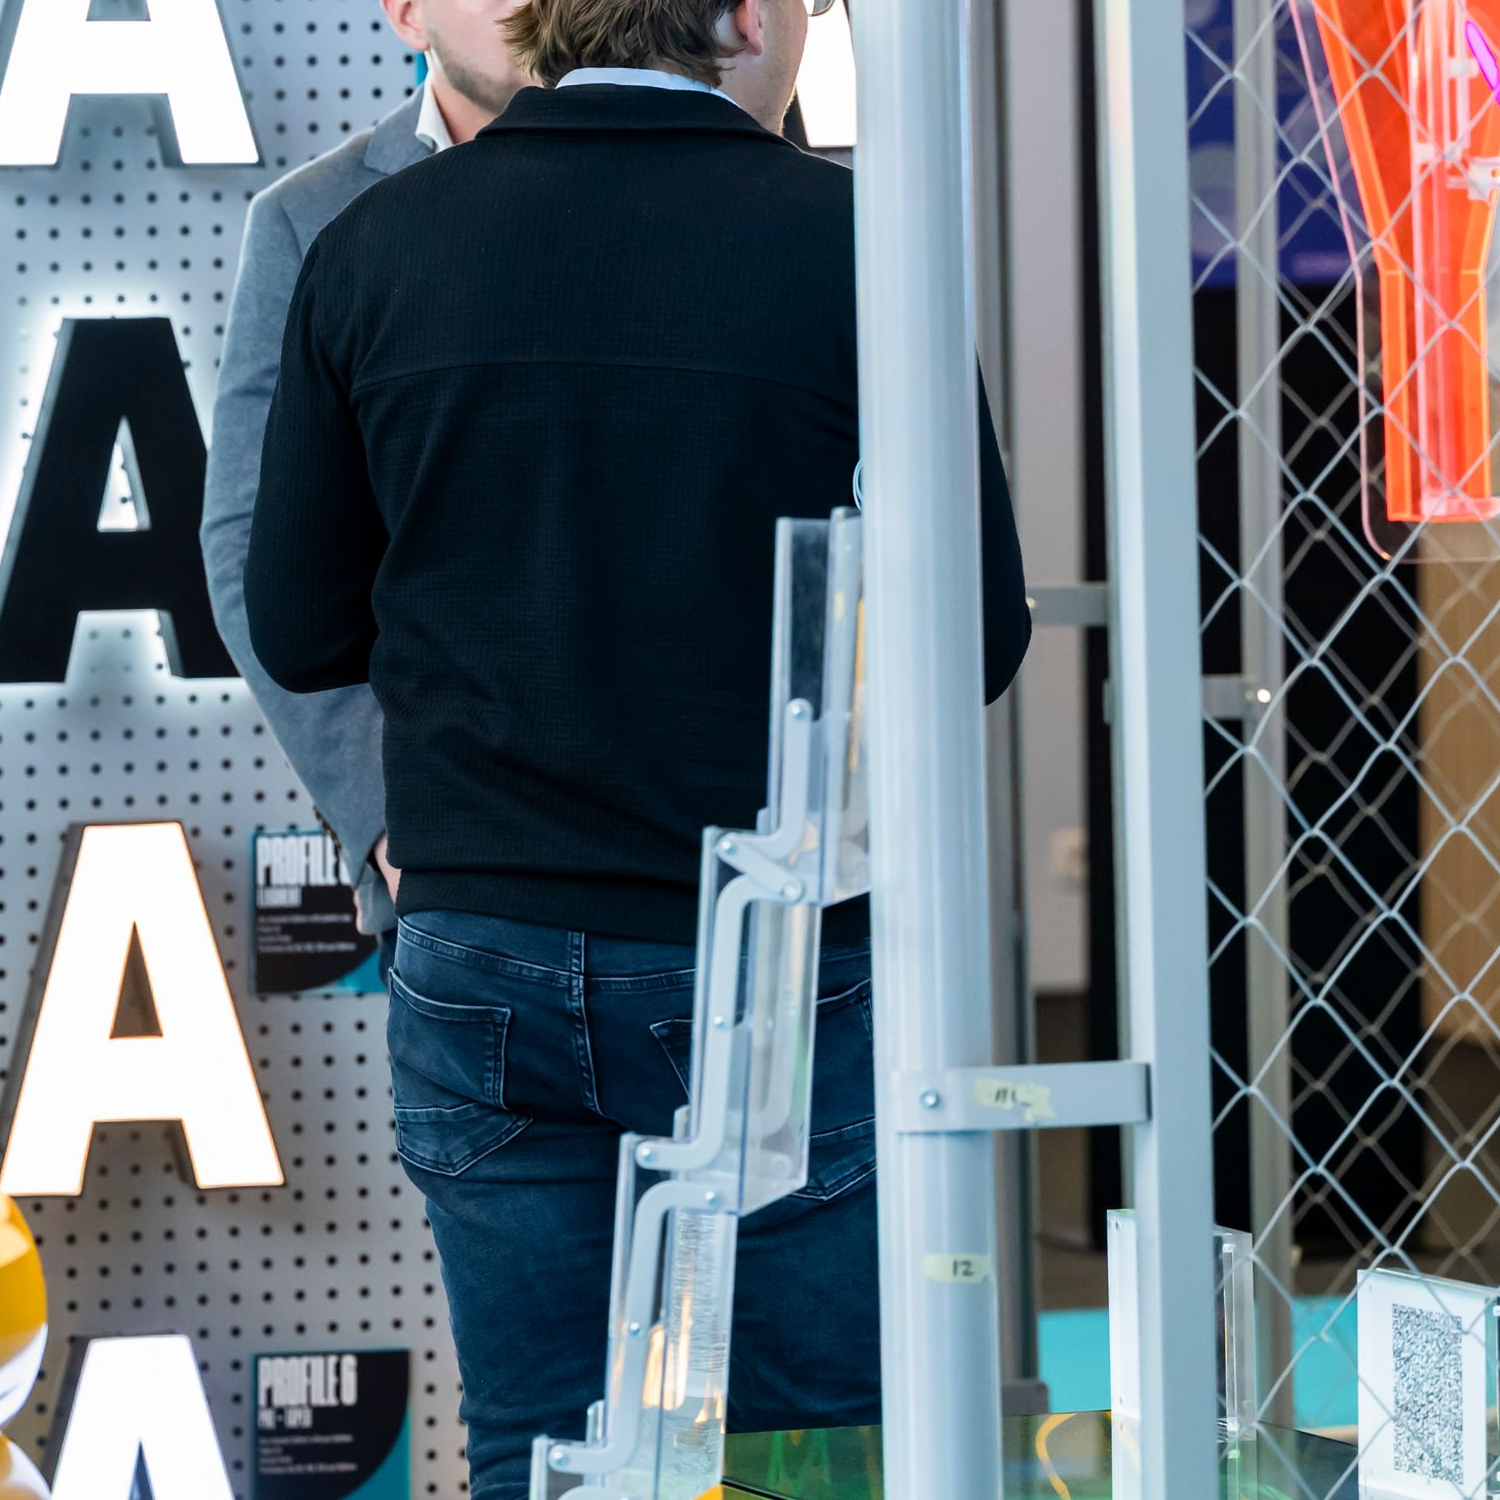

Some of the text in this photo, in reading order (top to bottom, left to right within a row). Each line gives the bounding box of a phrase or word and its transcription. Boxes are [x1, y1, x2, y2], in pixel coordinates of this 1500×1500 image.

[256, 836, 339, 887] PROFILE
[952, 1259, 975, 1278] 12
[257, 1354, 340, 1407] PROFILE
